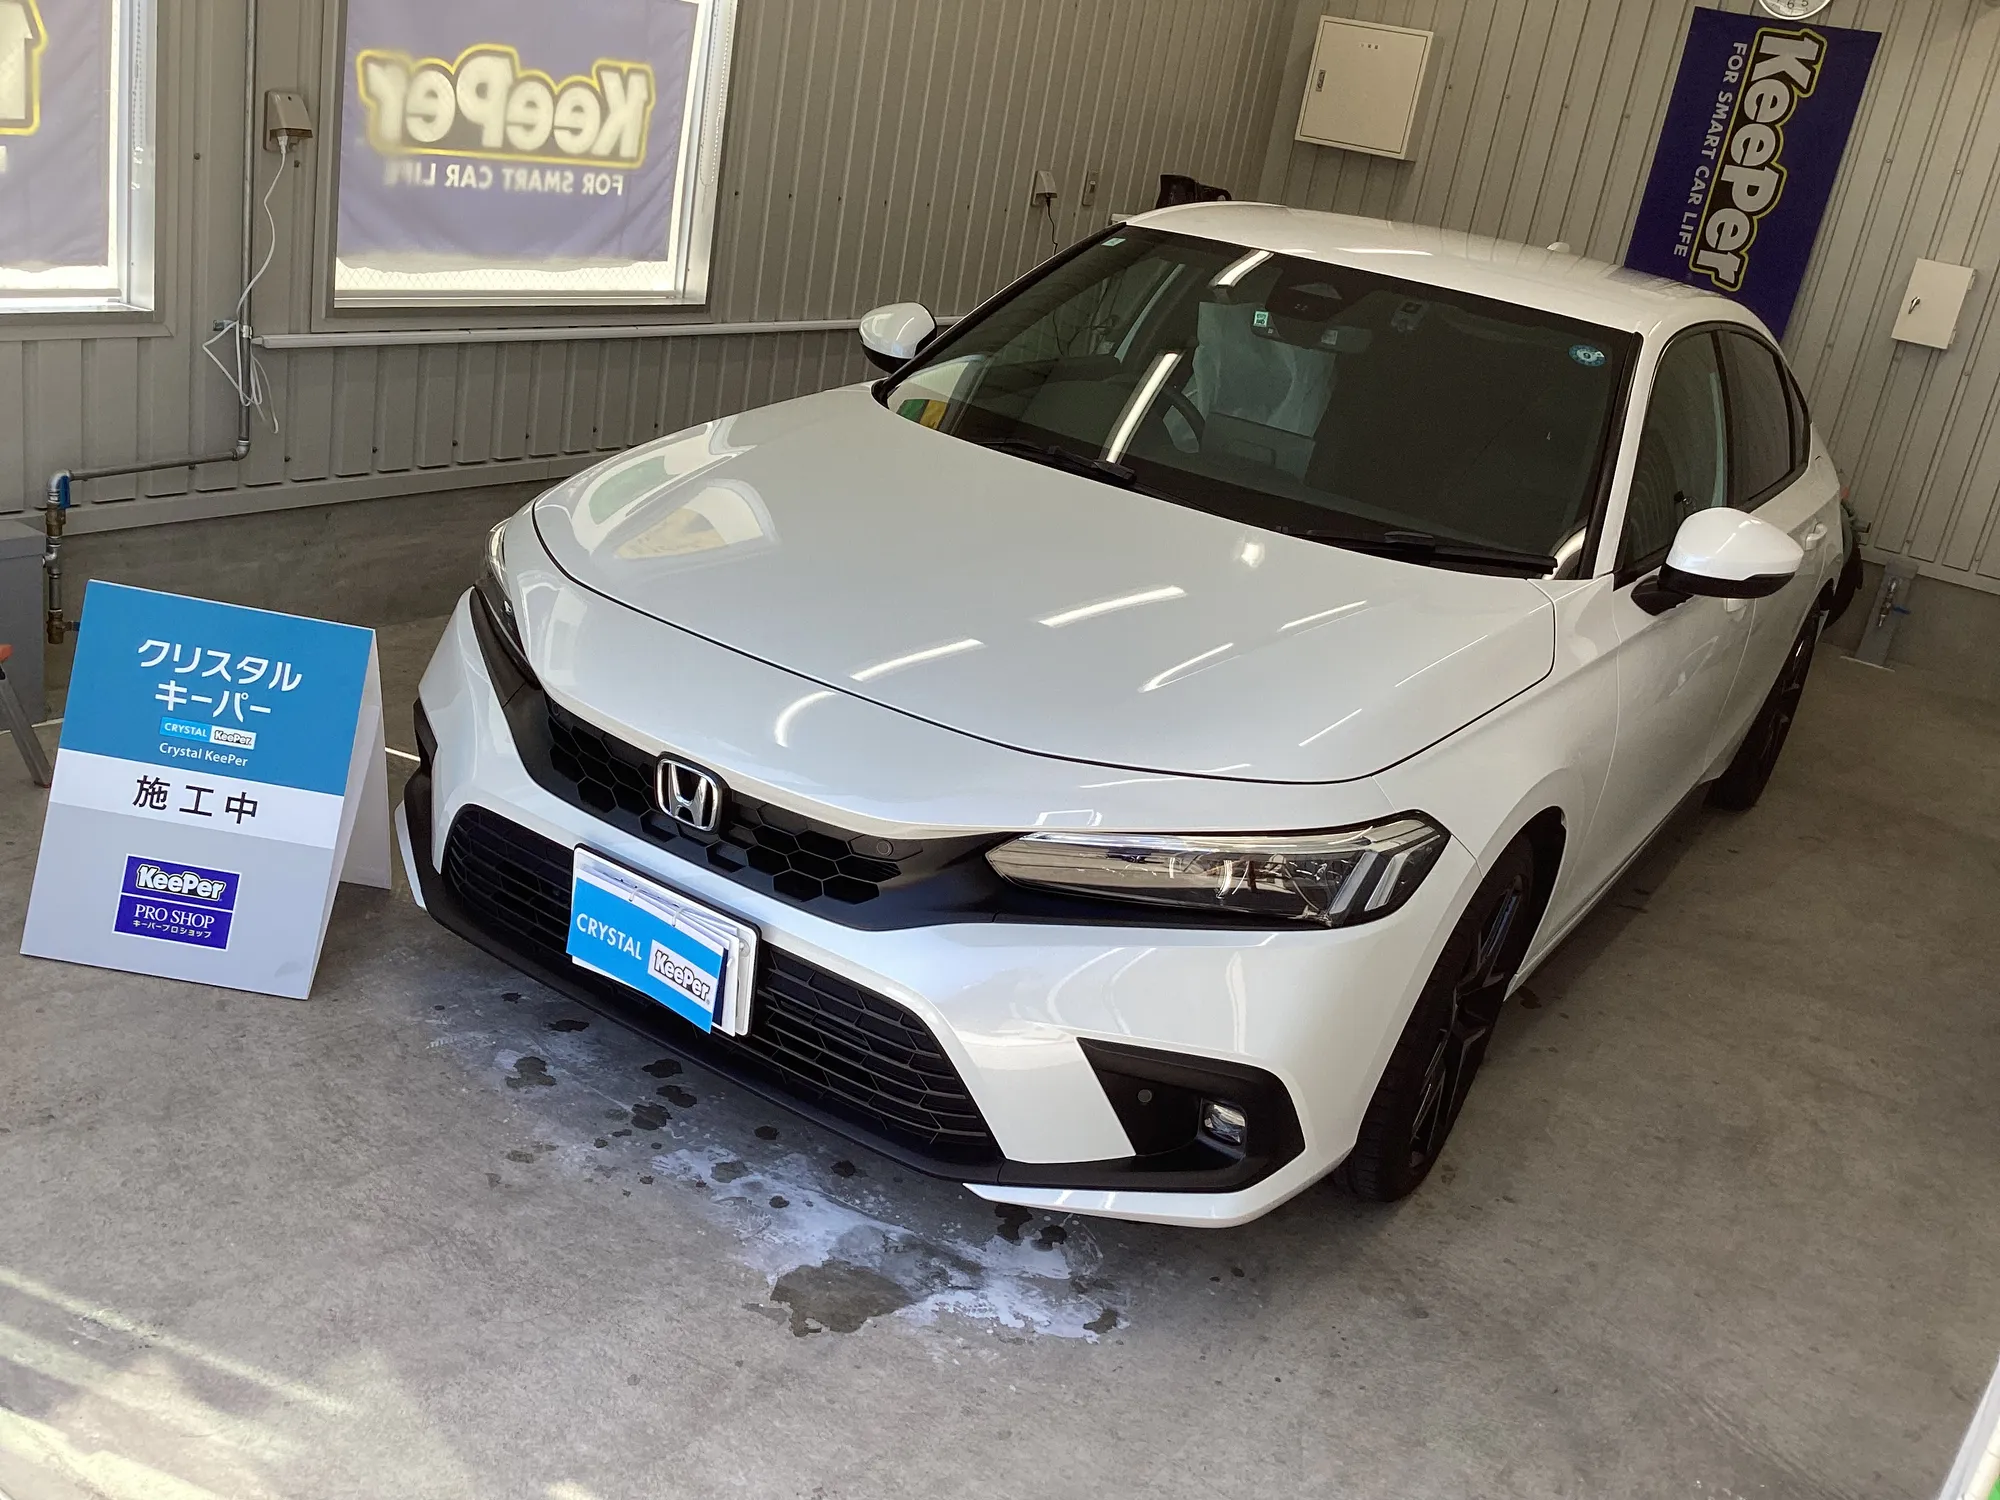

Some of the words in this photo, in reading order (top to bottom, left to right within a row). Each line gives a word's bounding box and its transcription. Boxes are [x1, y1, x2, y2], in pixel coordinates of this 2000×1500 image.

[1722, 42, 1748, 84] FOR
[1701, 90, 1733, 160] SMART
[1696, 35, 1819, 284] KeePer
[1687, 165, 1710, 204] CAR
[1673, 211, 1698, 257] LIFE
[137, 638, 303, 692] クリスタル
[154, 679, 272, 723] キーパー
[158, 742, 202, 759] Crystal
[204, 750, 249, 768] KeePer
[163, 722, 208, 738] CRYSTAL
[214, 729, 251, 745] KeePer
[132, 774, 259, 825] 施工中
[137, 864, 226, 900] KeePer
[134, 904, 169, 922] PRO
[170, 909, 215, 929] SHOP
[576, 913, 643, 961] CRYSTAL
[653, 949, 711, 1001] KeePer
